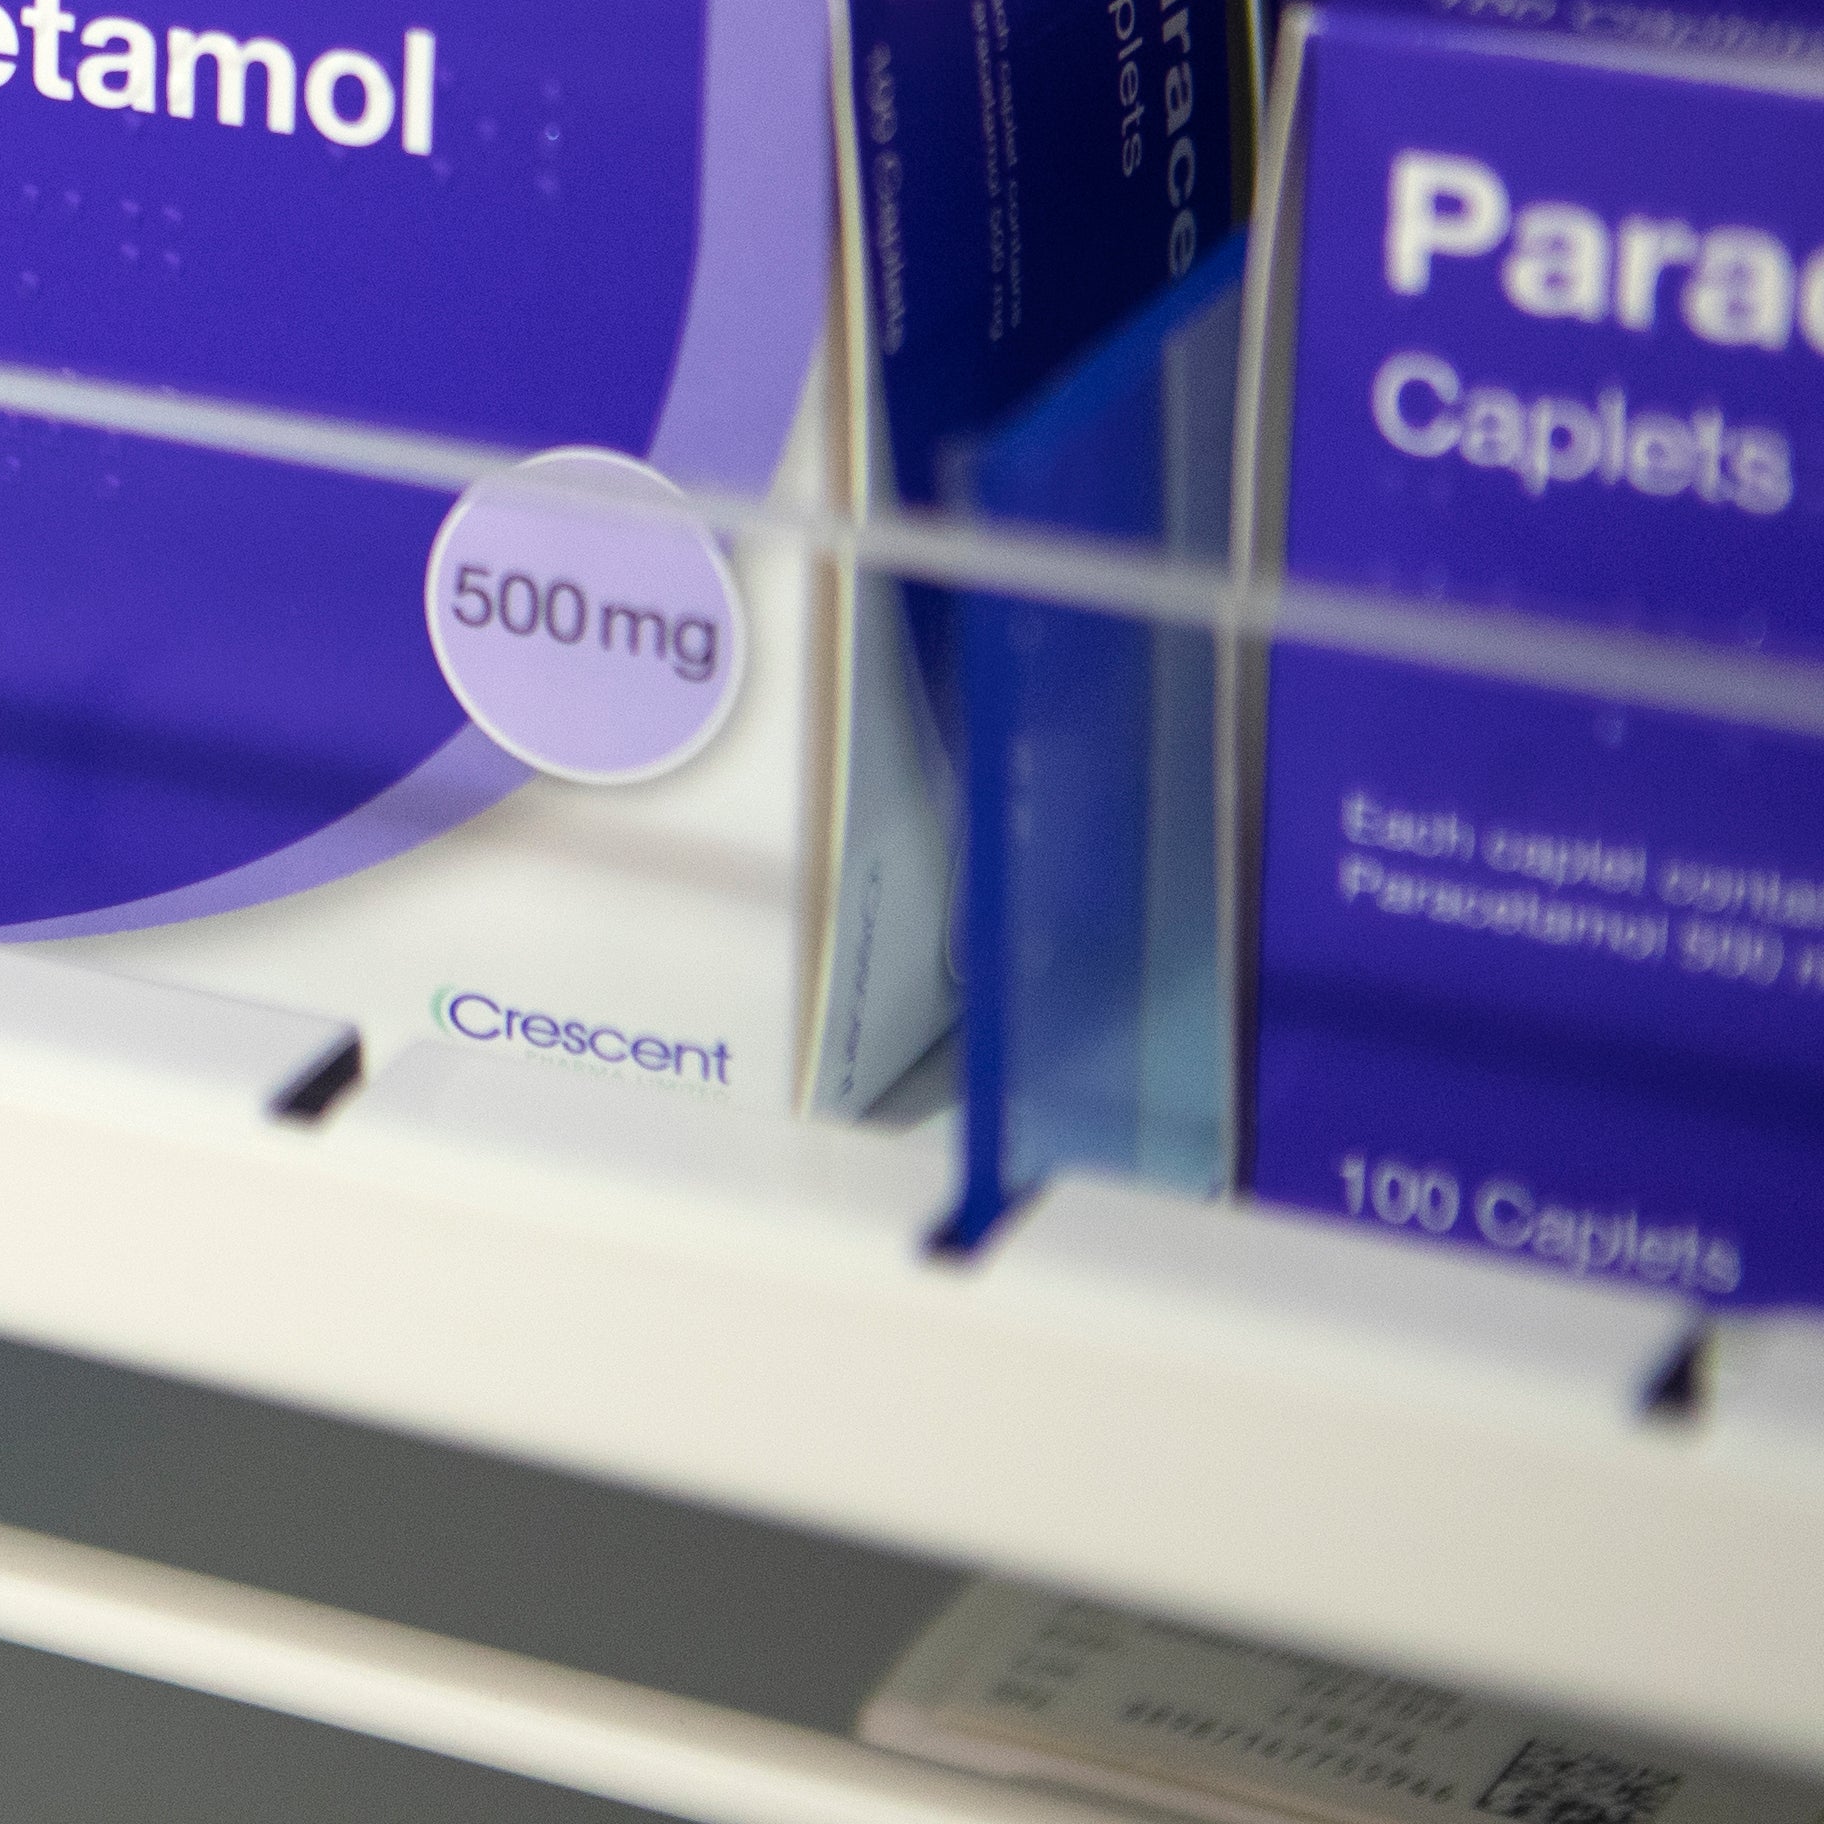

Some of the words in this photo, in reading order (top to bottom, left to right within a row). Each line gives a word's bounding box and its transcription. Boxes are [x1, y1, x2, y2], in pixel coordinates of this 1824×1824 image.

[1372, 349, 1795, 516] Caplets
[447, 992, 733, 1086] Crescent
[1340, 1152, 1461, 1236] 100
[1473, 1177, 1743, 1295] Caplets
